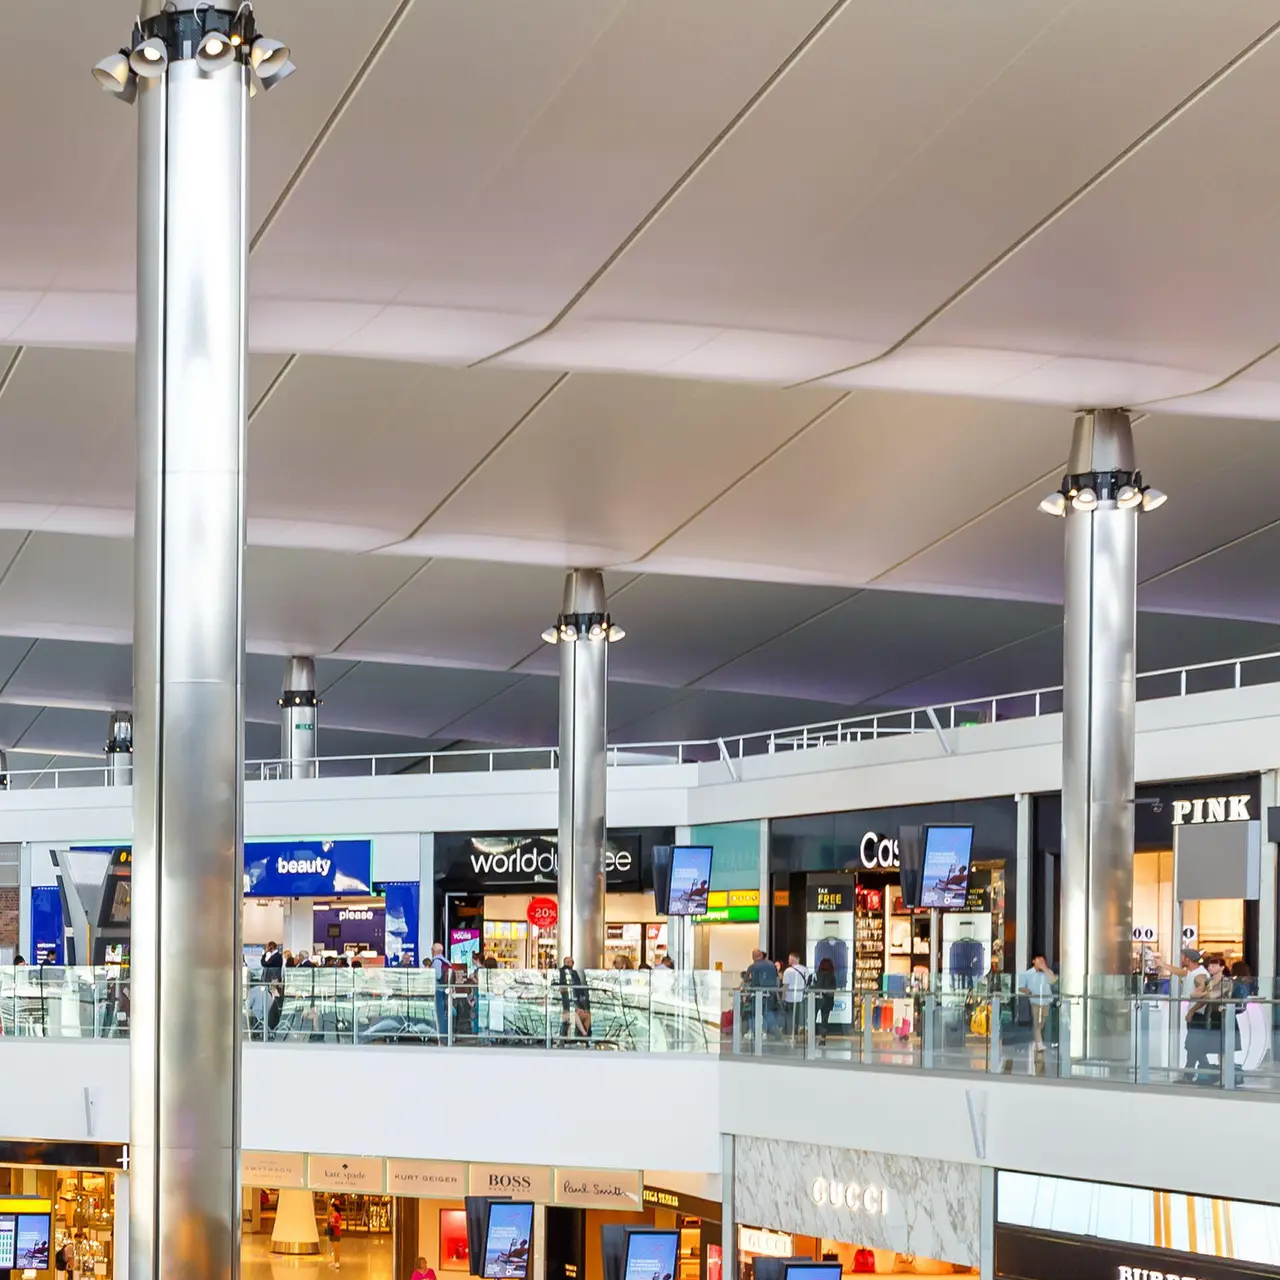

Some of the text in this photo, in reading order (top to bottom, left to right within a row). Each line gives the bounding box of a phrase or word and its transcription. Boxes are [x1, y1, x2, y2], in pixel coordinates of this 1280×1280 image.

[1172, 795, 1251, 825] PINK
[277, 856, 331, 876] beauty
[818, 893, 842, 905] FREE
[339, 910, 374, 921] please
[531, 907, 557, 918] -20%
[324, 1170, 366, 1182] kate spade
[394, 1174, 457, 1183] KURT GEIGER
[489, 1173, 531, 1189] BOSS
[563, 1180, 627, 1197] Paul Smith
[812, 1177, 889, 1216] GUCCI
[748, 1233, 788, 1254] GUCCI
